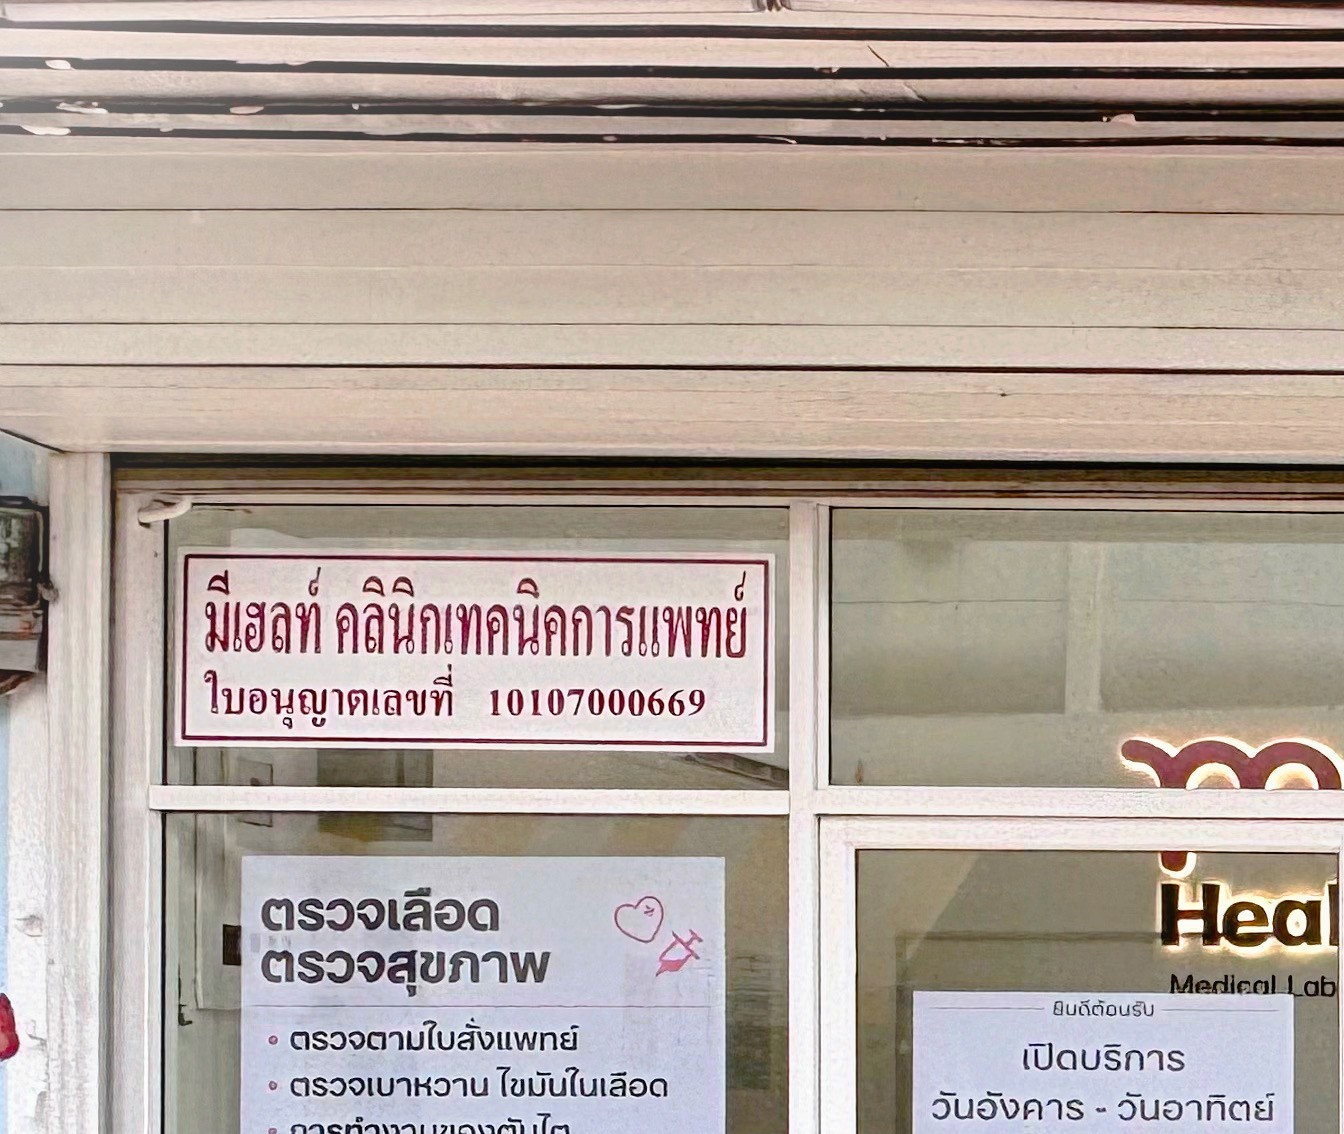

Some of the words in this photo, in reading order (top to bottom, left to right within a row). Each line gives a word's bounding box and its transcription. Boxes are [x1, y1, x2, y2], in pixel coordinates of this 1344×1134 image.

[204, 566, 322, 655] มีเฮลท์
[336, 570, 748, 659] คลินิกเทคนิคการแพทย์
[204, 665, 455, 729] ใบอนุญาตเลขที่
[488, 687, 706, 718] 10107000669
[261, 887, 501, 932] ตรวจเลือด
[261, 949, 552, 997] ตรวจสุขภาพ
[1052, 999, 1155, 1018] ยินดีต้อนรับ
[289, 1016, 580, 1052] ตรวจตามใบสั่งแพทย์
[1022, 1042, 1186, 1073] เปิดบริการ
[289, 1075, 489, 1099] ตรวจเบาหวาน
[496, 1066, 669, 1099] ไขมันในเลือด
[931, 1091, 1086, 1122] วันอังคาร
[1117, 1091, 1276, 1122] วันอาทิตย์
